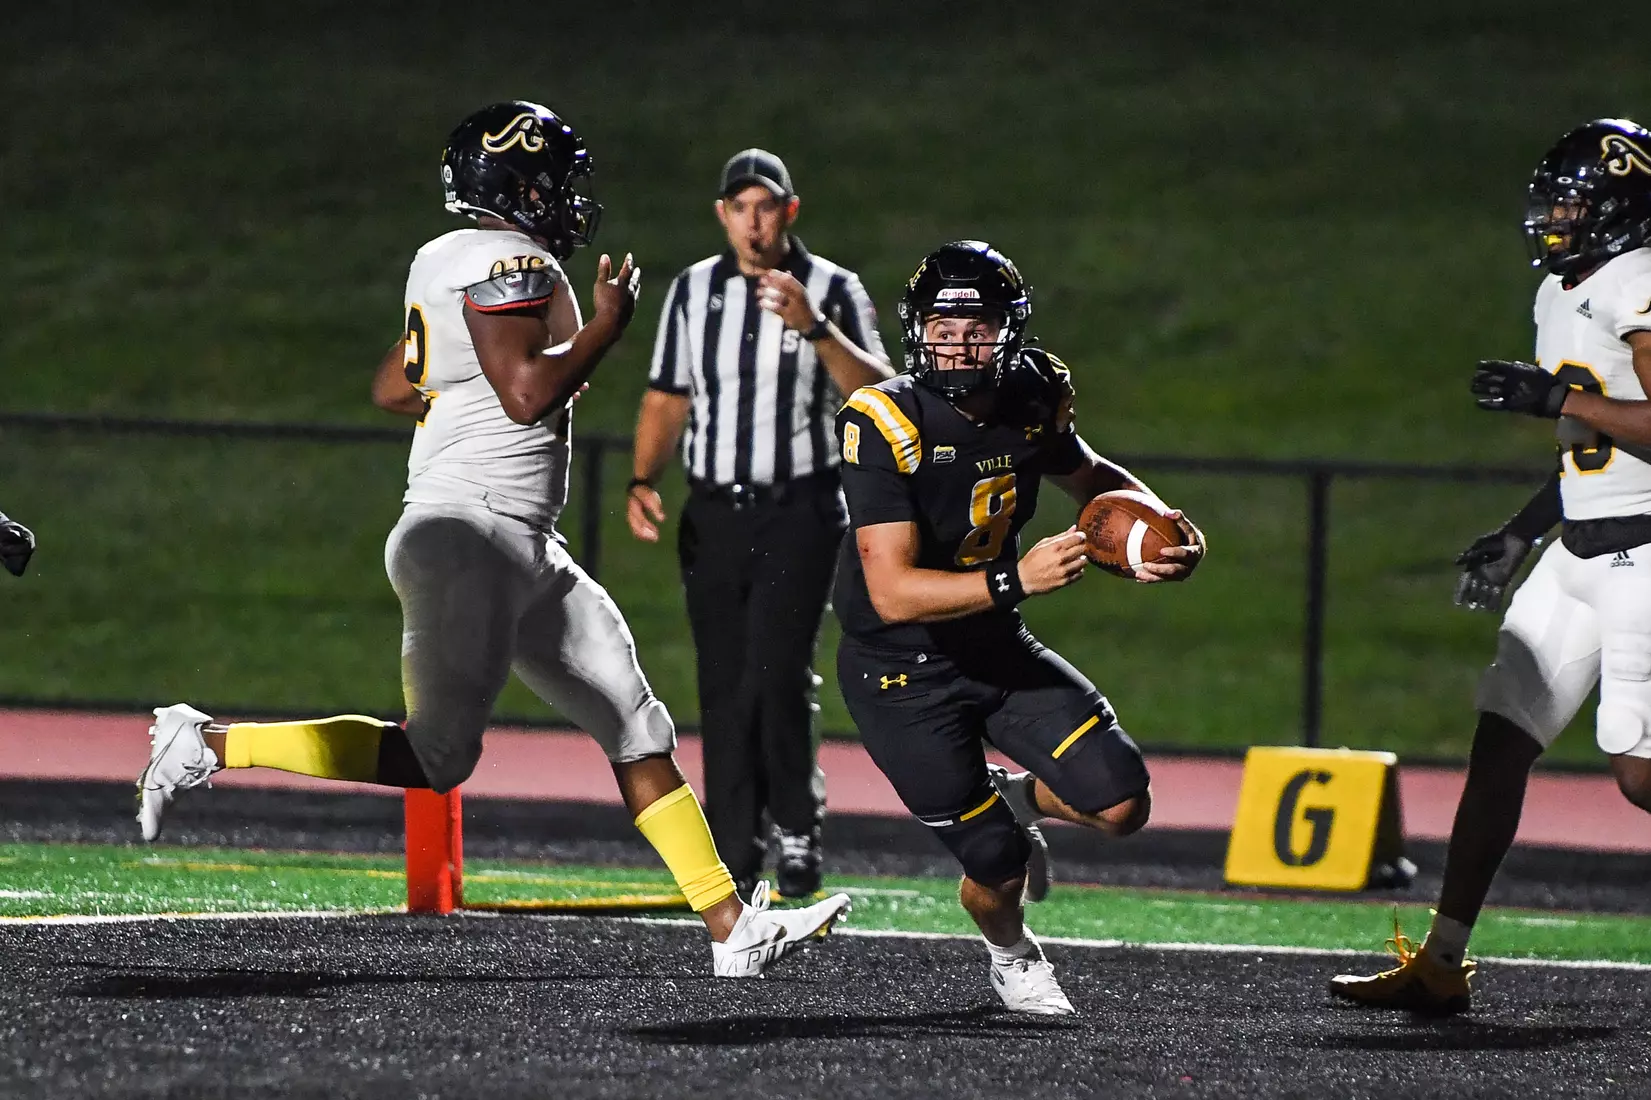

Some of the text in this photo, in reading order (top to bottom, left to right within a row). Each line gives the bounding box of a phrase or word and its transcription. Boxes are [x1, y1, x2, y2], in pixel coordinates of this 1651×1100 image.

[843, 421, 860, 465] 8
[975, 454, 1012, 473] VILLE
[954, 472, 1018, 567] 8
[1274, 769, 1335, 867] G
